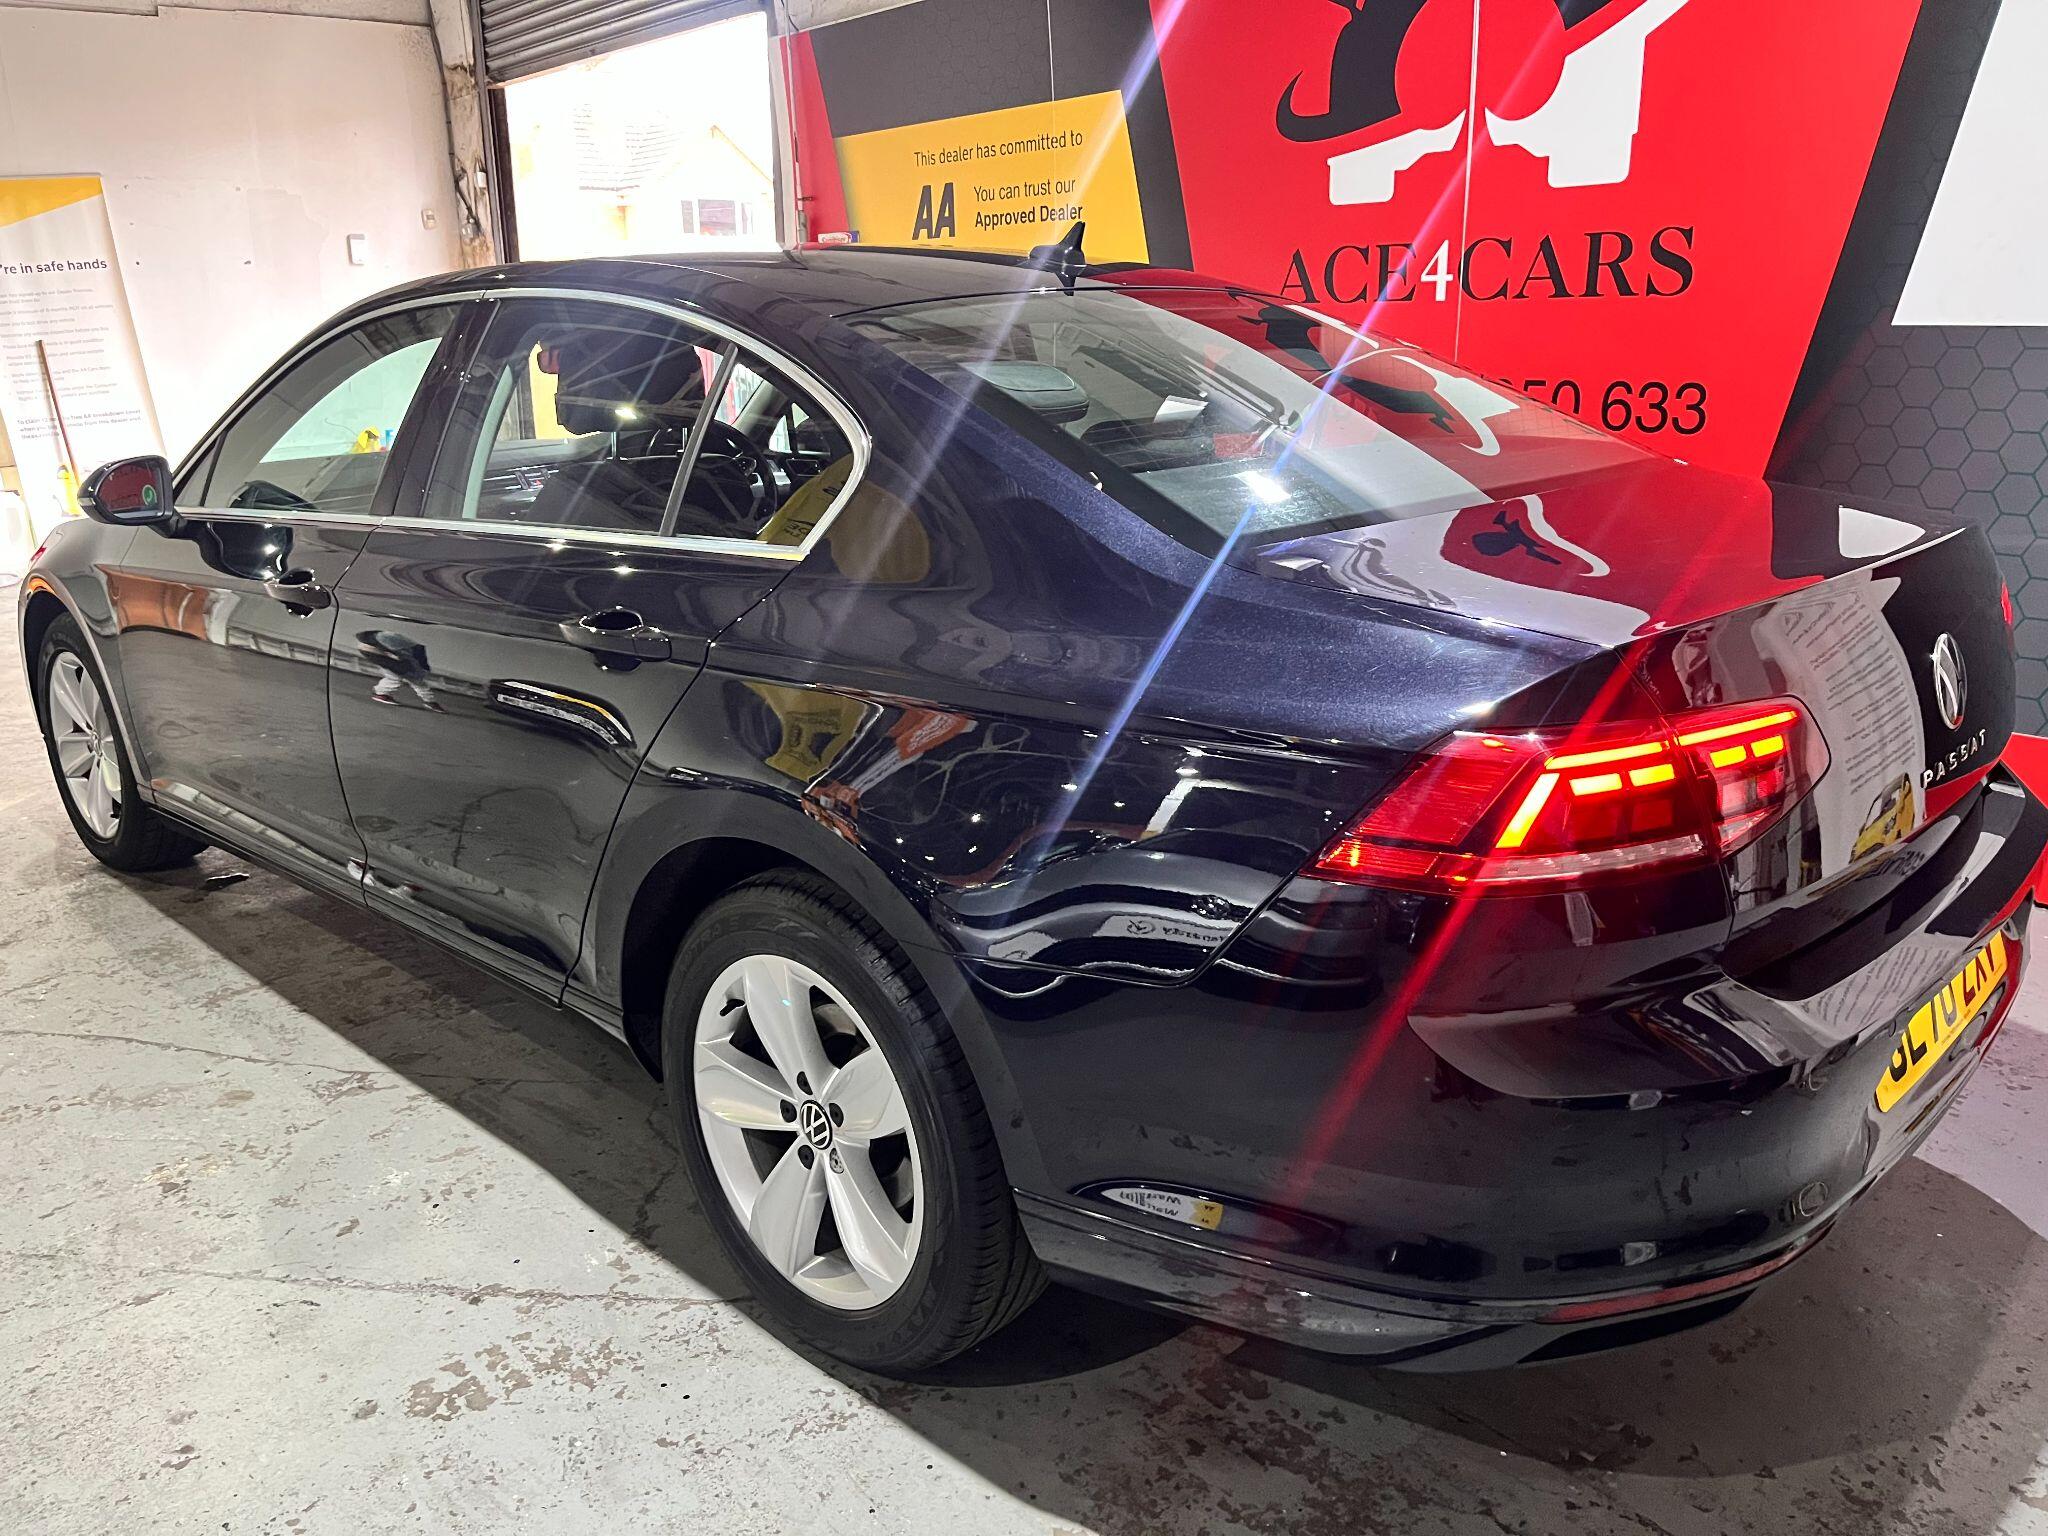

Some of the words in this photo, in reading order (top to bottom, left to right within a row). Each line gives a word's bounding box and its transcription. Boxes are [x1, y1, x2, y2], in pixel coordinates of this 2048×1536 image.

[913, 150, 936, 167] This
[939, 146, 973, 164] dealer
[976, 142, 996, 159] has
[999, 130, 1067, 157] committed
[1070, 129, 1083, 147] to
[911, 182, 956, 241] AA
[973, 185, 995, 202] You
[999, 185, 1020, 200] can
[1024, 178, 1051, 197] trust
[1055, 179, 1076, 194] our
[975, 206, 1036, 231] Approved
[1040, 203, 1083, 222] Dealer
[19, 262, 33, 274] in
[36, 260, 64, 273] safe
[67, 258, 108, 271] hands
[1279, 225, 1695, 305] ACE4CARS
[1601, 380, 1707, 435] 633
[1921, 728, 1987, 790] PASSAT
